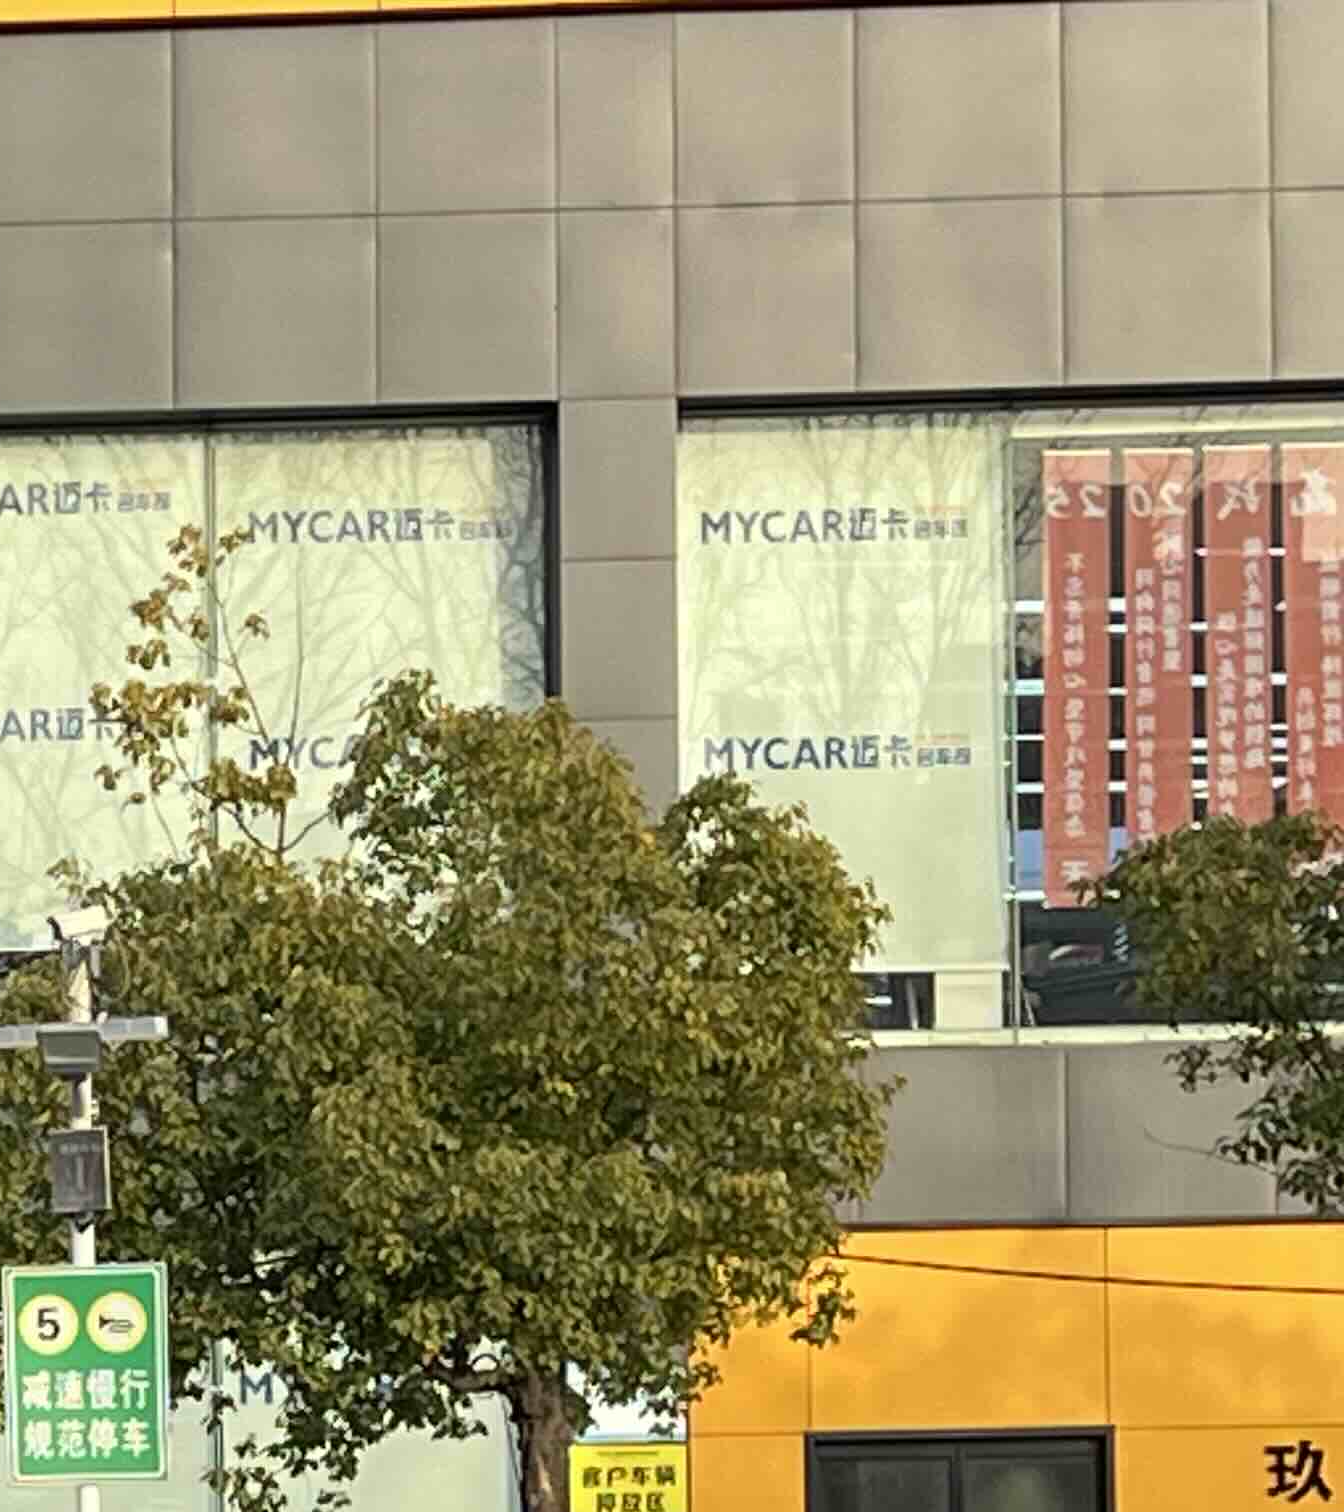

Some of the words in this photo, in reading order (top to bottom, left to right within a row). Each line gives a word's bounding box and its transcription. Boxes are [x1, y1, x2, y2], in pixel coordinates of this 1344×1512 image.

[37, 1306, 60, 1341] 5
[24, 1417, 151, 1460] 规范停车
